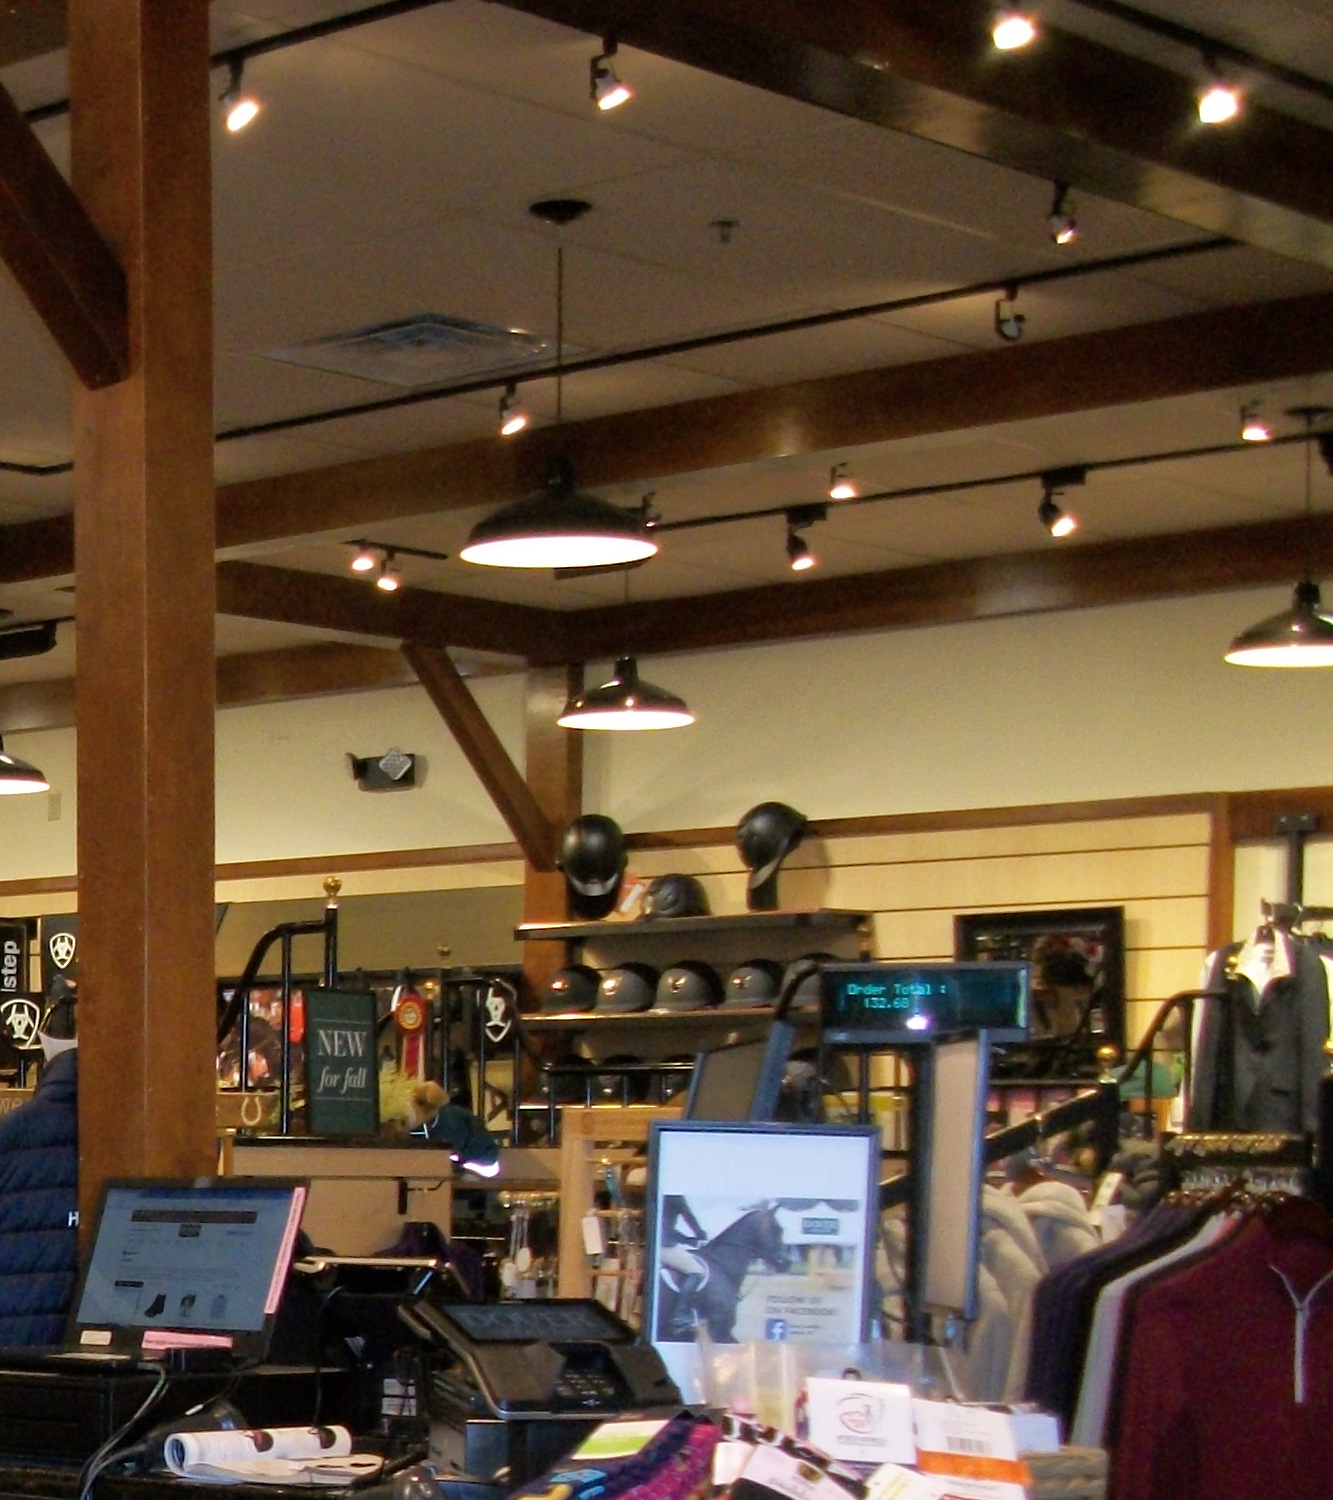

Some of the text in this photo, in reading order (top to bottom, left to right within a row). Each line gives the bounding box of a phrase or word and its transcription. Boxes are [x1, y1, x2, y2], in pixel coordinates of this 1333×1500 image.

[846, 983, 886, 995] Order
[893, 983, 932, 995] Total
[318, 1029, 367, 1057] NEW
[316, 1066, 368, 1095] for fall
